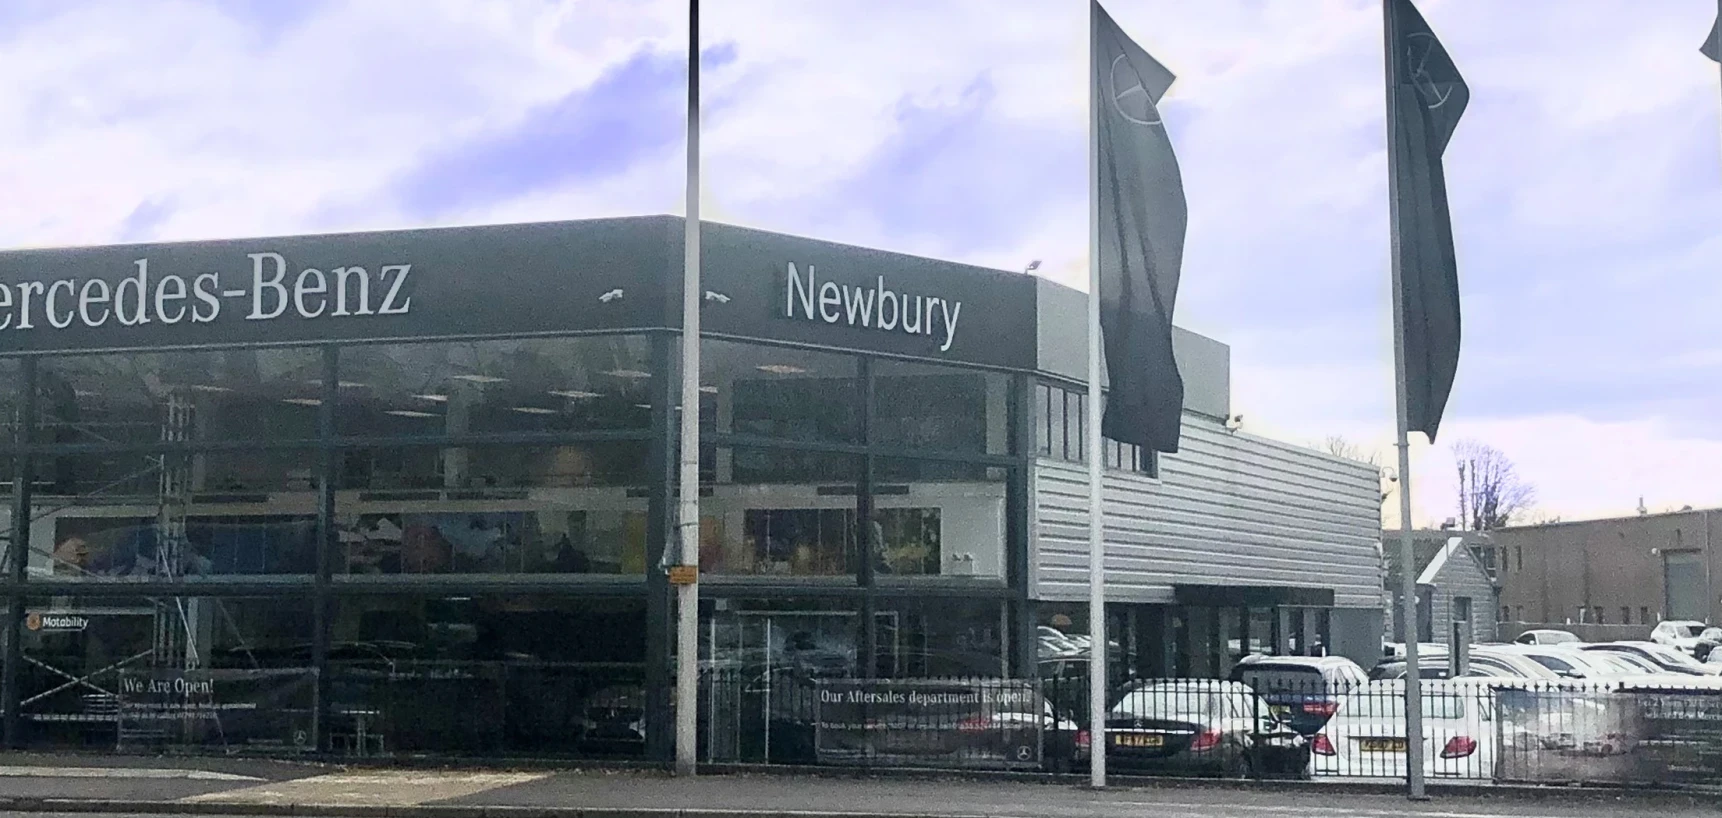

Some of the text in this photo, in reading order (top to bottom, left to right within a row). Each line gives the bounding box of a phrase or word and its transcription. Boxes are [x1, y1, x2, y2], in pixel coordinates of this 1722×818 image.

[786, 261, 961, 351] Newbury
[42, 616, 89, 630] Motability
[124, 677, 214, 697] We Are Open!
[820, 689, 844, 704] Our
[848, 689, 906, 704] Aftersales
[909, 690, 980, 707] department
[983, 691, 995, 704] is
